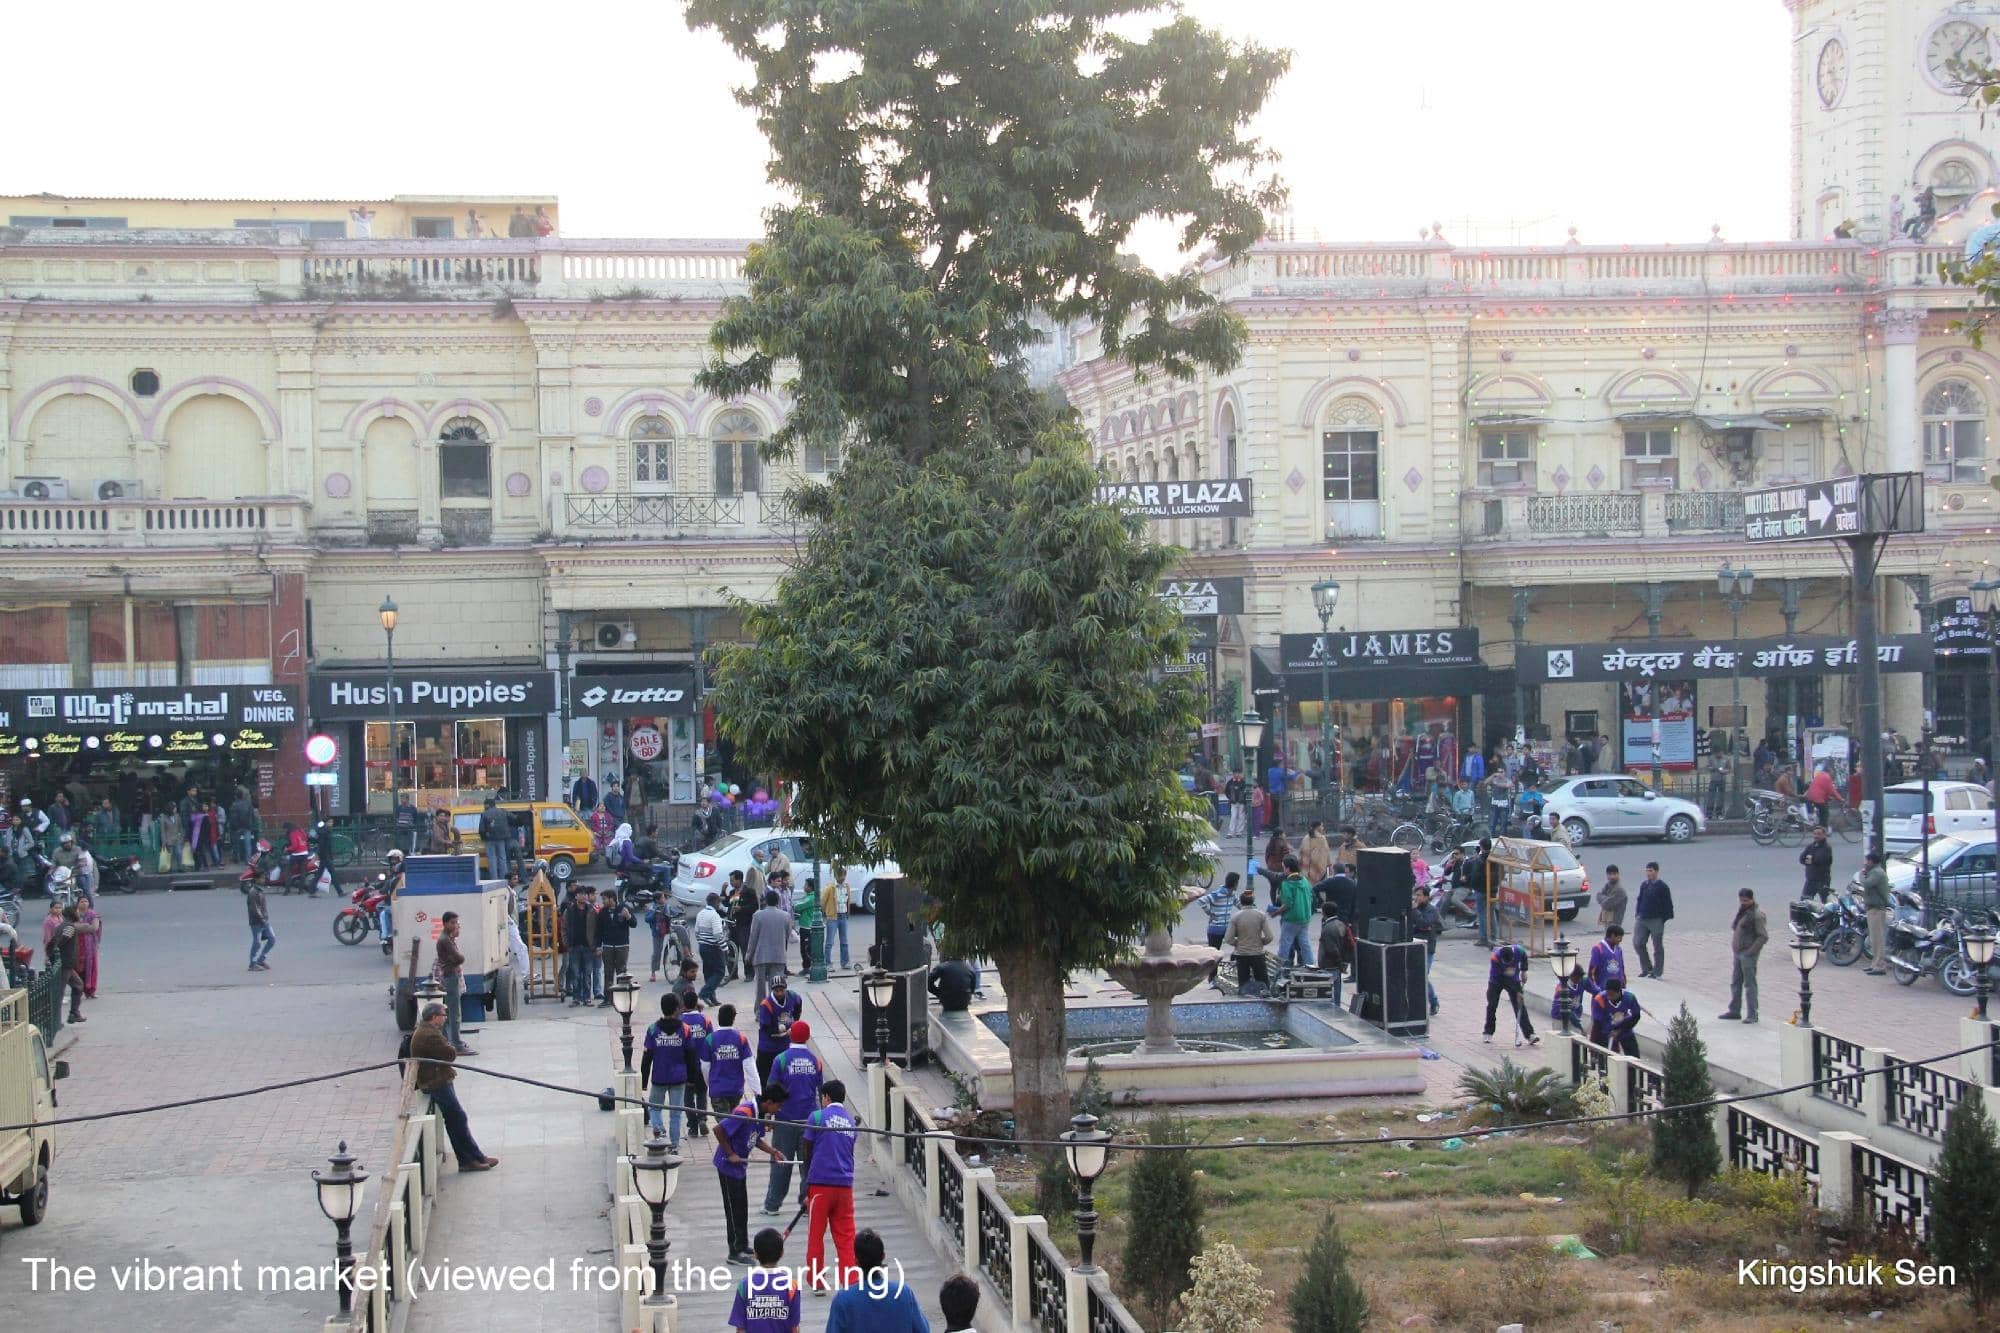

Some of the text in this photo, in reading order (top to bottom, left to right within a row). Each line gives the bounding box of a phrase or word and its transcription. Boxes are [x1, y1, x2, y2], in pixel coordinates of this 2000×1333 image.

[1167, 482, 1244, 505] PLAZA
[1171, 504, 1220, 515] LUCKNOW
[1308, 632, 1453, 659] A JAMES
[253, 690, 287, 702] VEG.
[330, 680, 527, 708] Hush Puppies
[244, 707, 295, 723] DINNER
[525, 730, 537, 773] Puppies
[746, 1306, 789, 1319] WIZARDS
